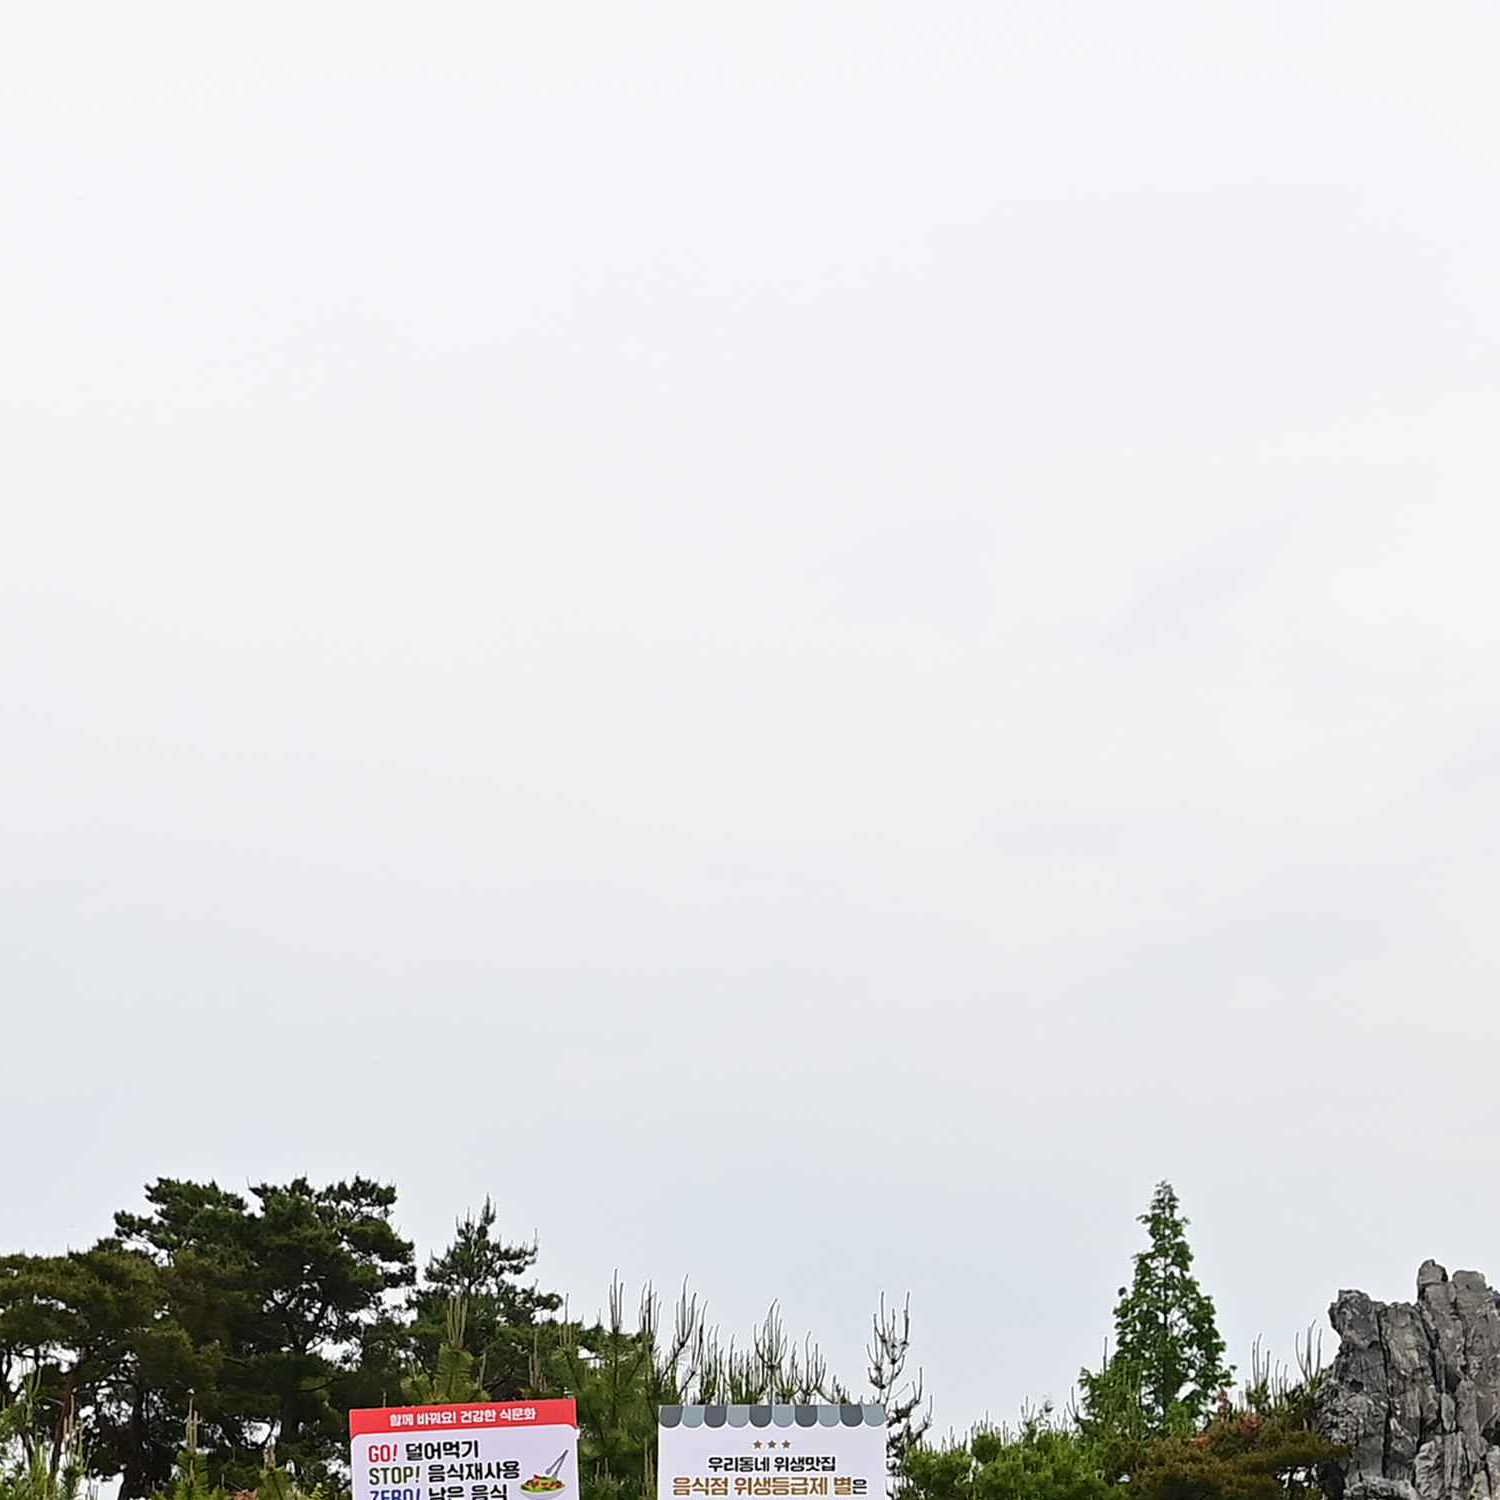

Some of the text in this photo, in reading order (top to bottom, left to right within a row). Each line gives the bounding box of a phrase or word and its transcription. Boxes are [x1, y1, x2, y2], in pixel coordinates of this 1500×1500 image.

[389, 1413, 414, 1427] 함께
[460, 1409, 497, 1424] 건강한
[500, 1407, 536, 1421] 식문화
[368, 1440, 479, 1463] GO! 덜어먹기
[369, 1461, 520, 1486] STOP! 음식재사용
[708, 1456, 836, 1473] 우리동네 위생맛집
[672, 1477, 868, 1496] 음식점 위생등급제 별은
